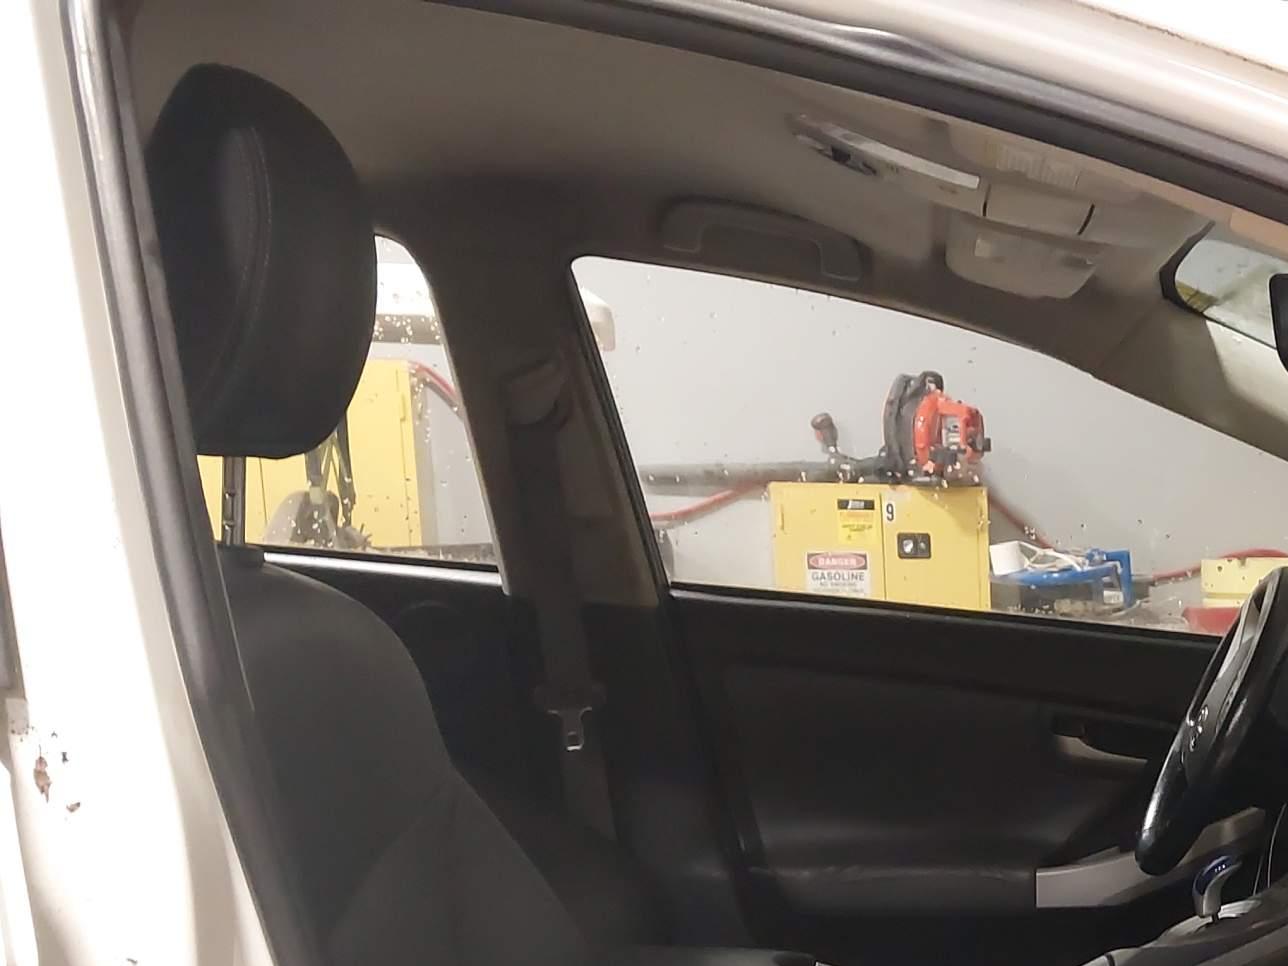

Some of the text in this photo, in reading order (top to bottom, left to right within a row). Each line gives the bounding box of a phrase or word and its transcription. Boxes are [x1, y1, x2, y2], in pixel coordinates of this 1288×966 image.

[886, 503, 895, 521] 9
[818, 557, 857, 566] DANGER
[811, 572, 865, 581] GASOLINE
